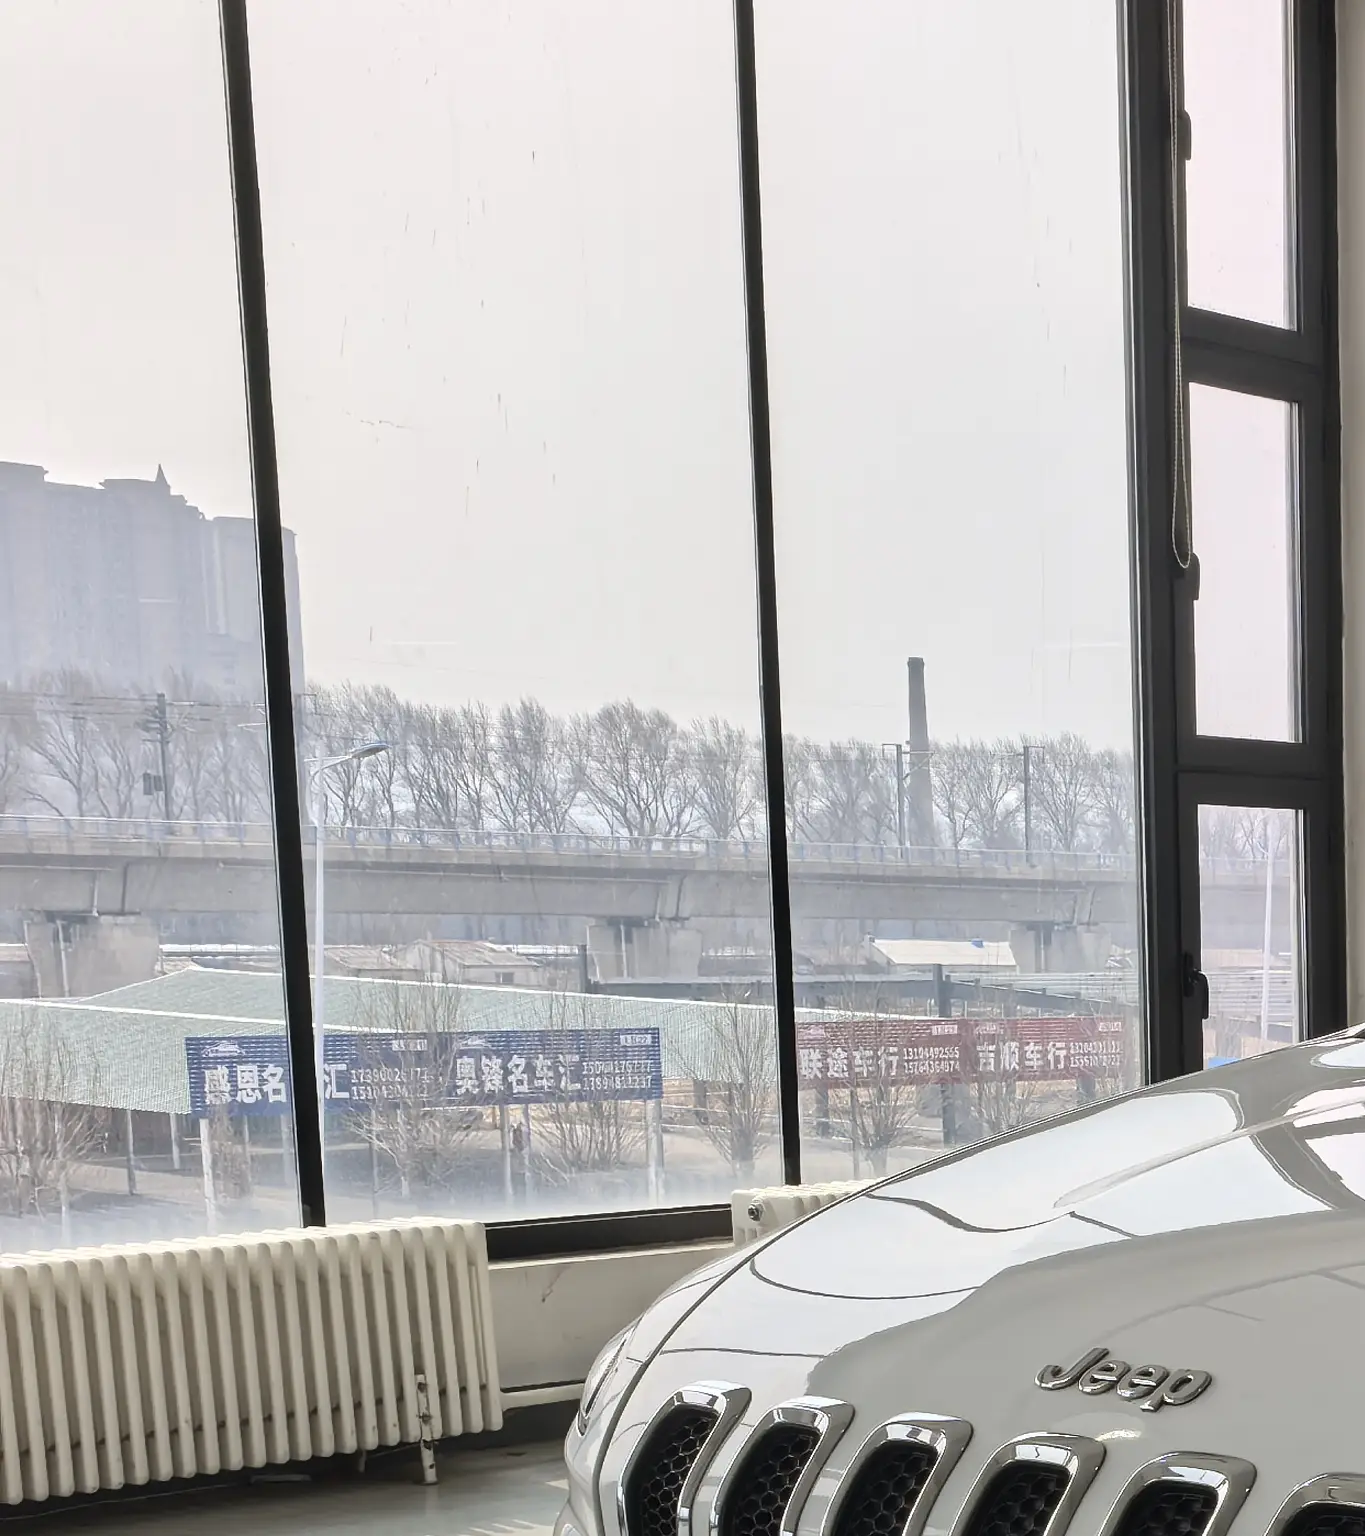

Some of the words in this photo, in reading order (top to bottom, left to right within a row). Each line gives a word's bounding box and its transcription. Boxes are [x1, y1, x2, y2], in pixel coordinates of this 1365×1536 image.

[204, 1063, 350, 1106] 感恩名汇
[1034, 1347, 1212, 1412] Jeep
